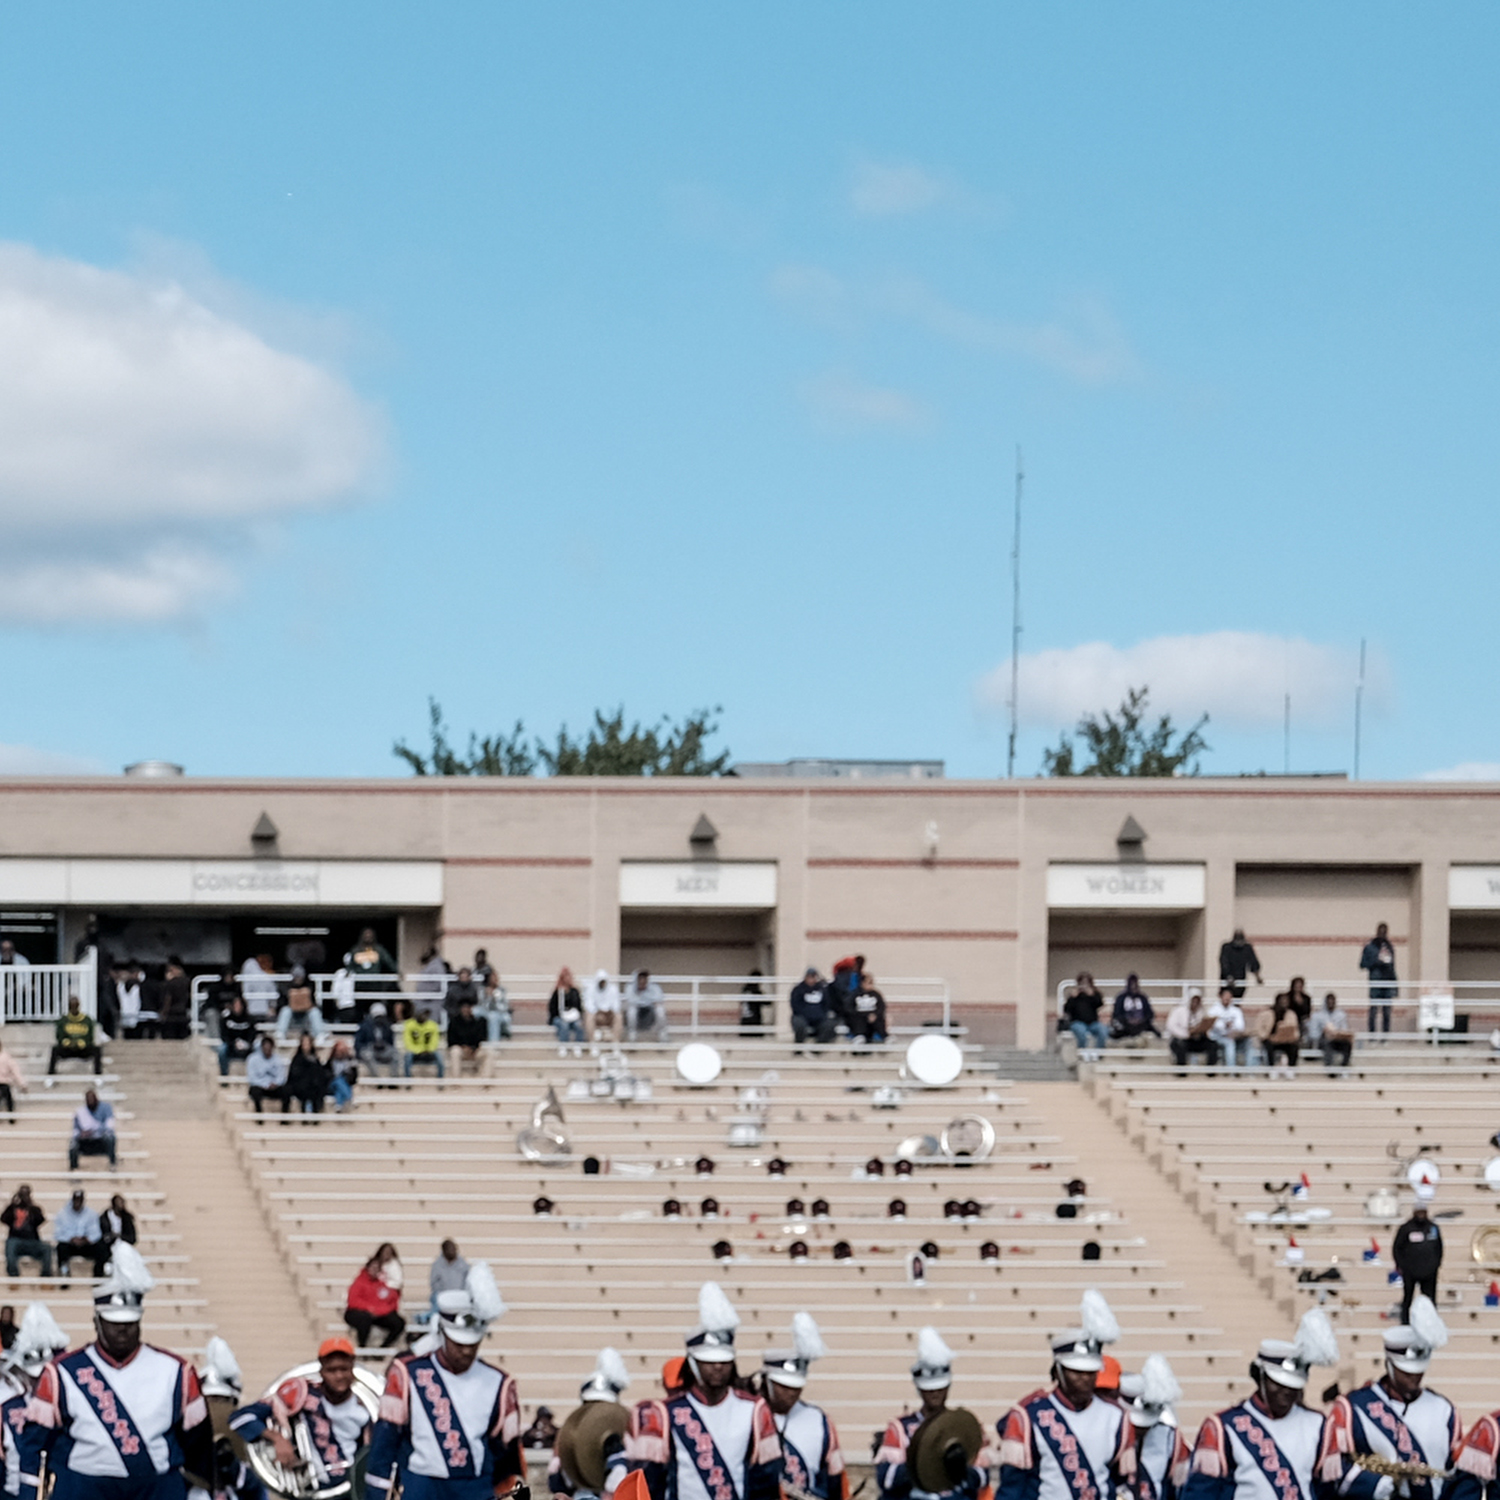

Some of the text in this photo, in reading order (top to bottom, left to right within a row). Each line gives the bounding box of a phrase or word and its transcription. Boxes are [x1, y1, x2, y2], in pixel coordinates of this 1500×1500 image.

[676, 878, 719, 893] MEN
[1086, 876, 1165, 894] WOMEN
[76, 1366, 140, 1455] MORGAN
[416, 1368, 468, 1467] MORGAN
